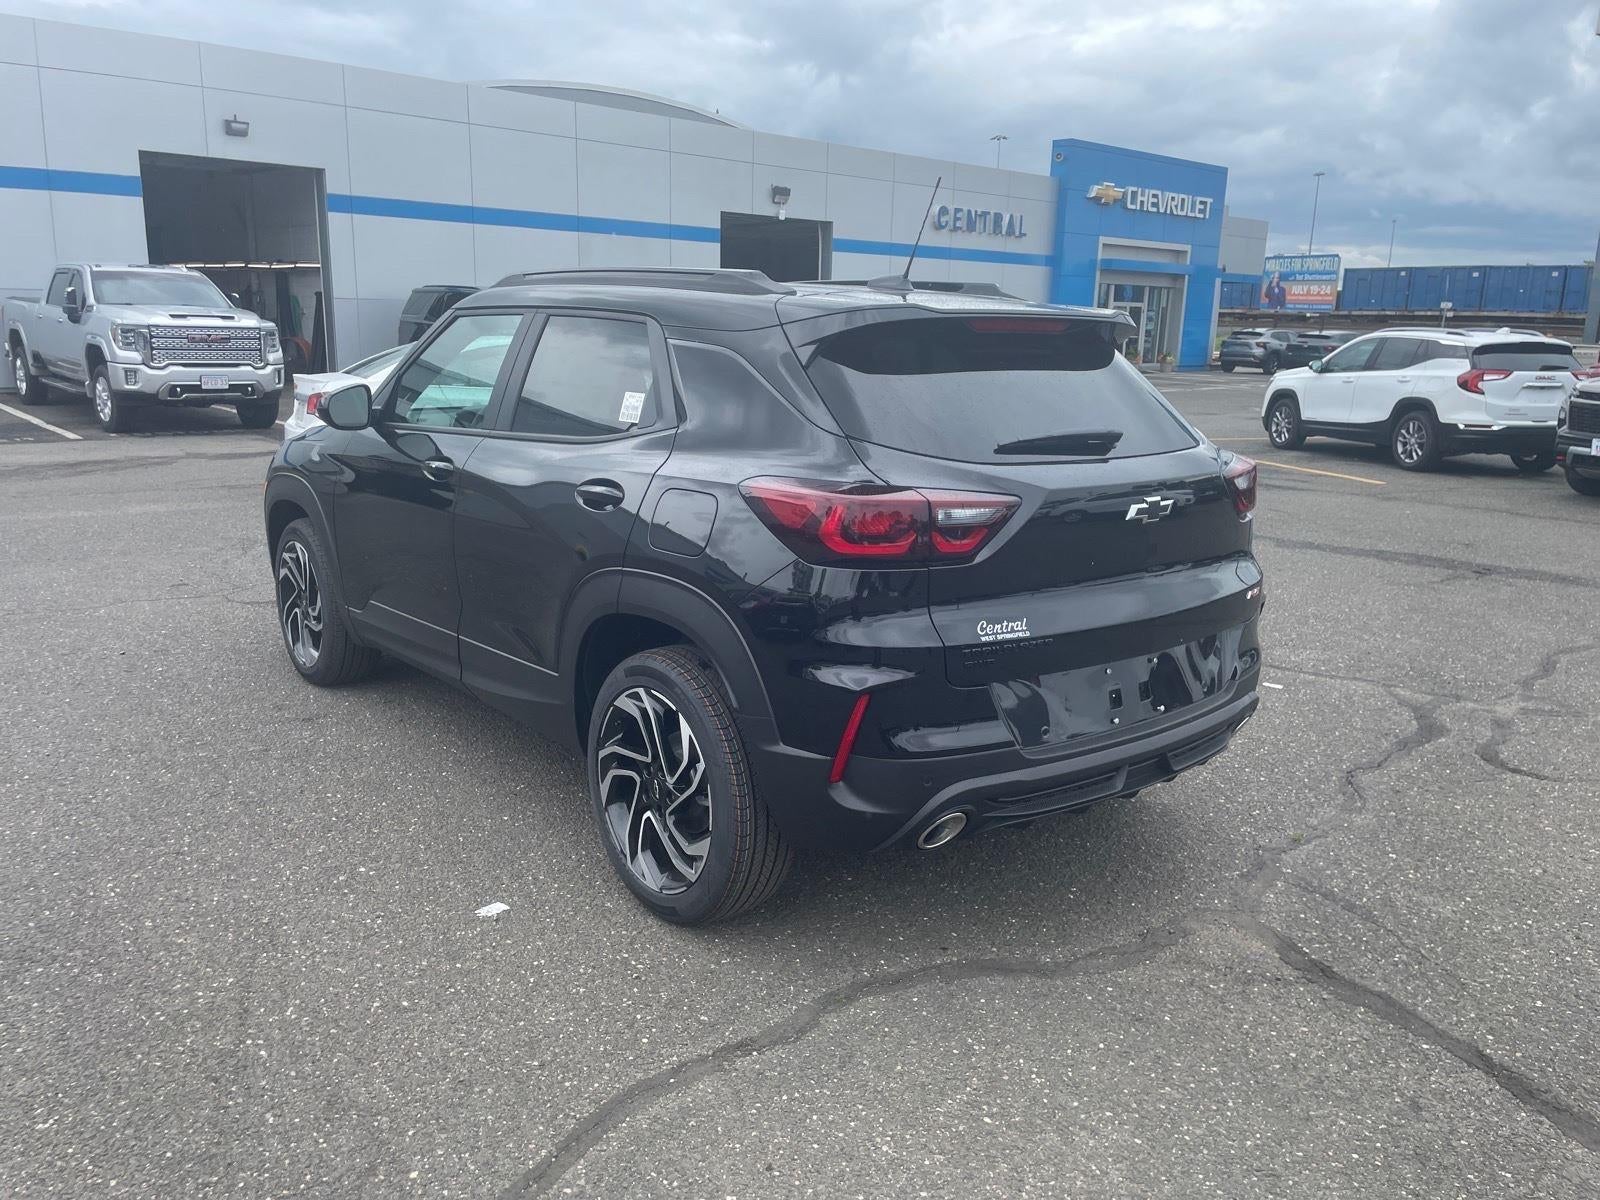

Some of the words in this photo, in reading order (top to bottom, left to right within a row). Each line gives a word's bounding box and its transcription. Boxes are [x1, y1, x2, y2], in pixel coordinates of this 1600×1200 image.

[1125, 185, 1213, 219] CHEVROLET
[933, 205, 1027, 238] CENTRAL
[1291, 285, 1309, 295] JULY
[188, 334, 230, 343] GMC
[977, 617, 1028, 635] Central
[996, 631, 1030, 640] SPRINGFIELD
